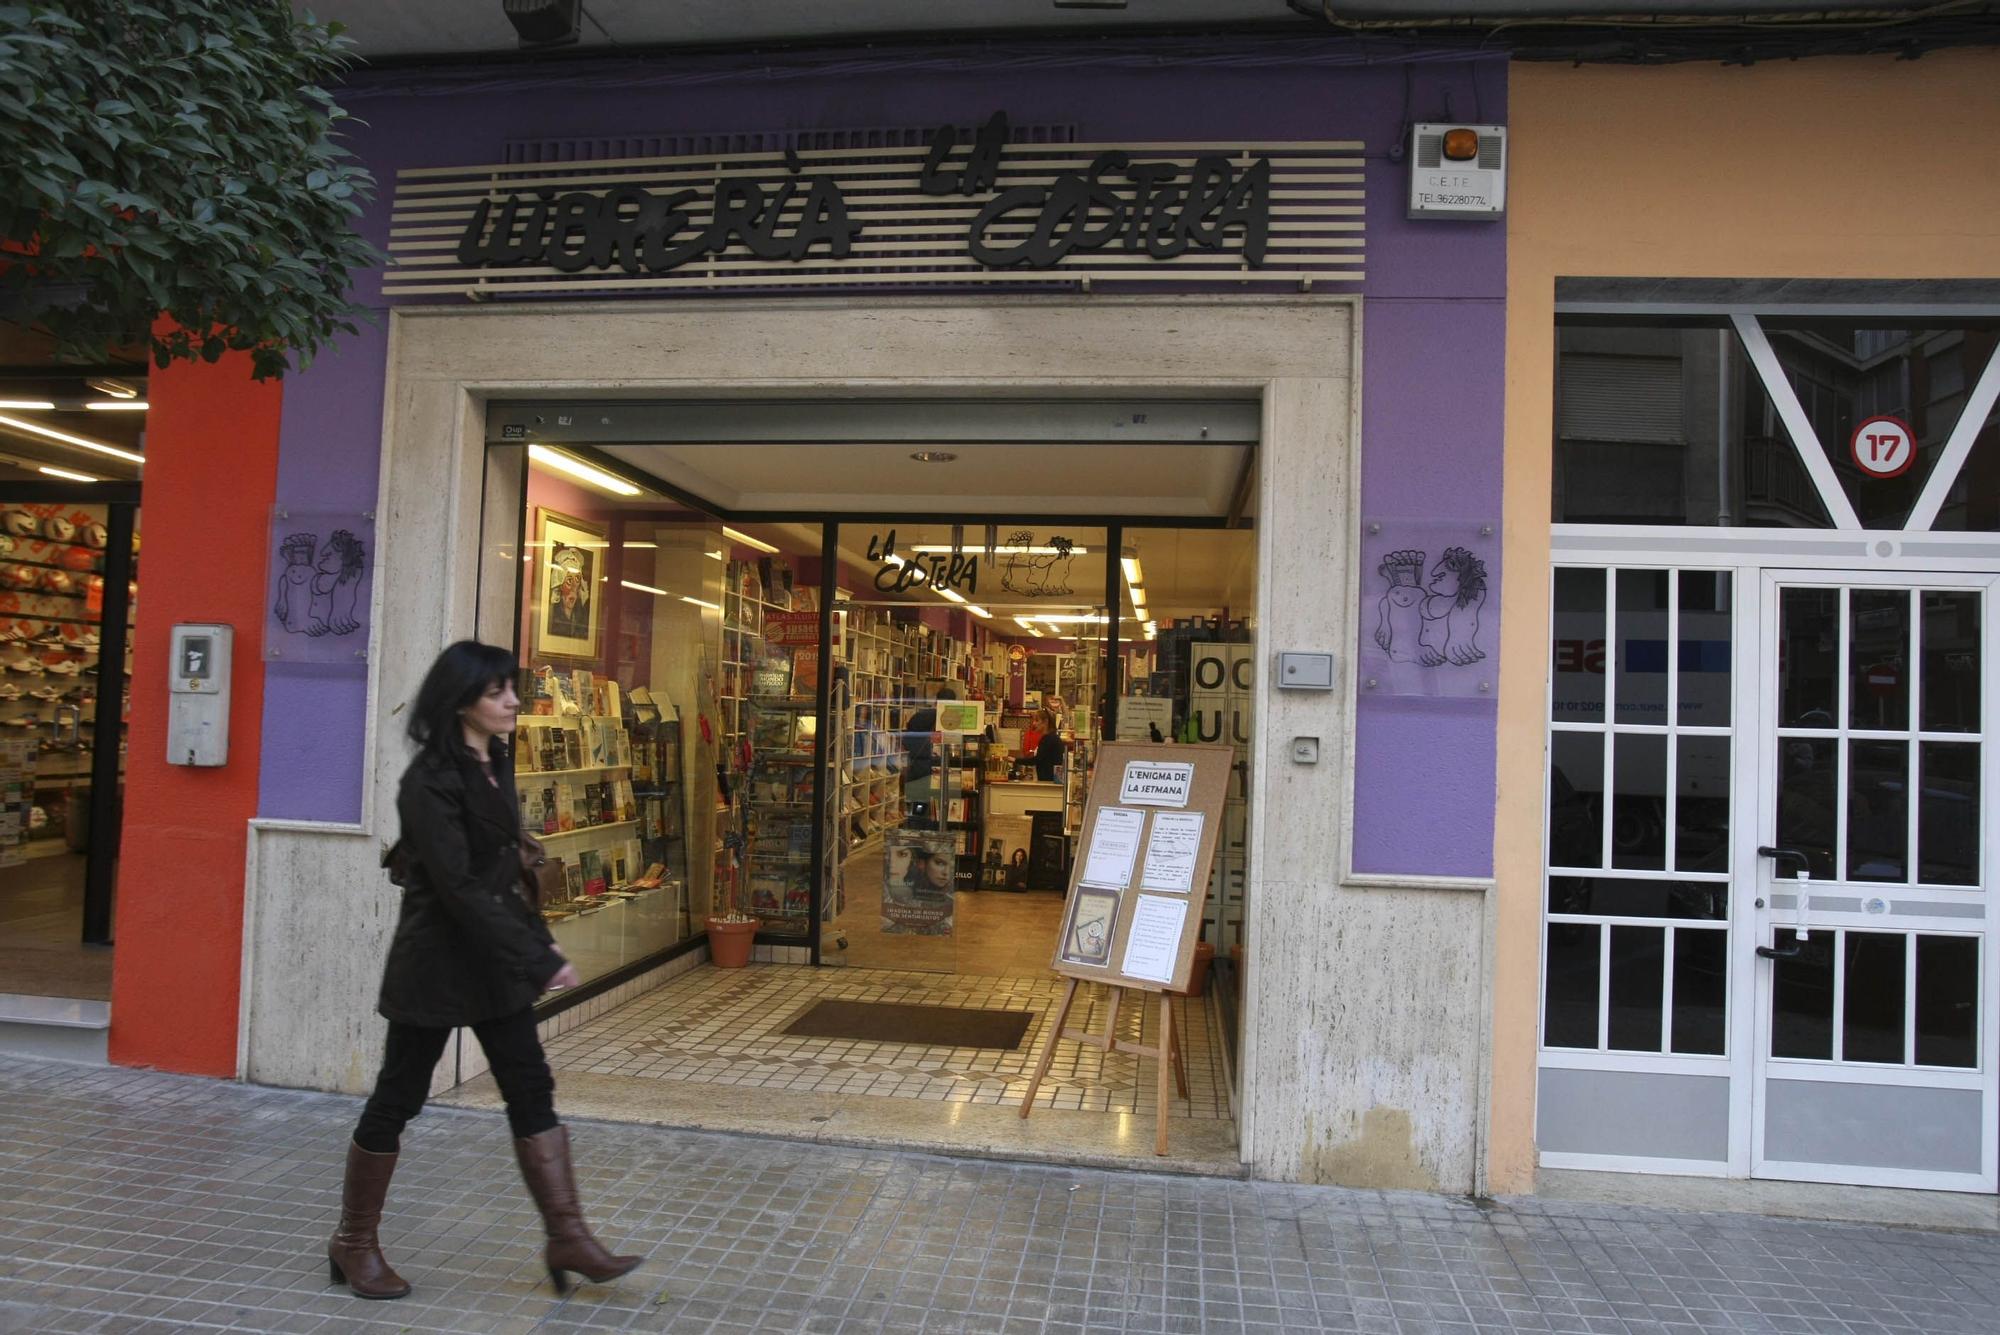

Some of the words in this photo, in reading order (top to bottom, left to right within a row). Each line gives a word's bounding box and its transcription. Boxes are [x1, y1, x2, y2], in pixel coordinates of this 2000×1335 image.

[920, 110, 1008, 197] LA
[968, 150, 1271, 268] COSTERA
[1865, 434, 1901, 462] 17
[867, 529, 896, 561] LA
[874, 551, 978, 595] COSTERA
[1128, 784, 1139, 793] LA
[1141, 785, 1182, 795] SETMANA
[1129, 770, 1172, 781] L'ENIGMA
[1174, 773, 1187, 782] DE
